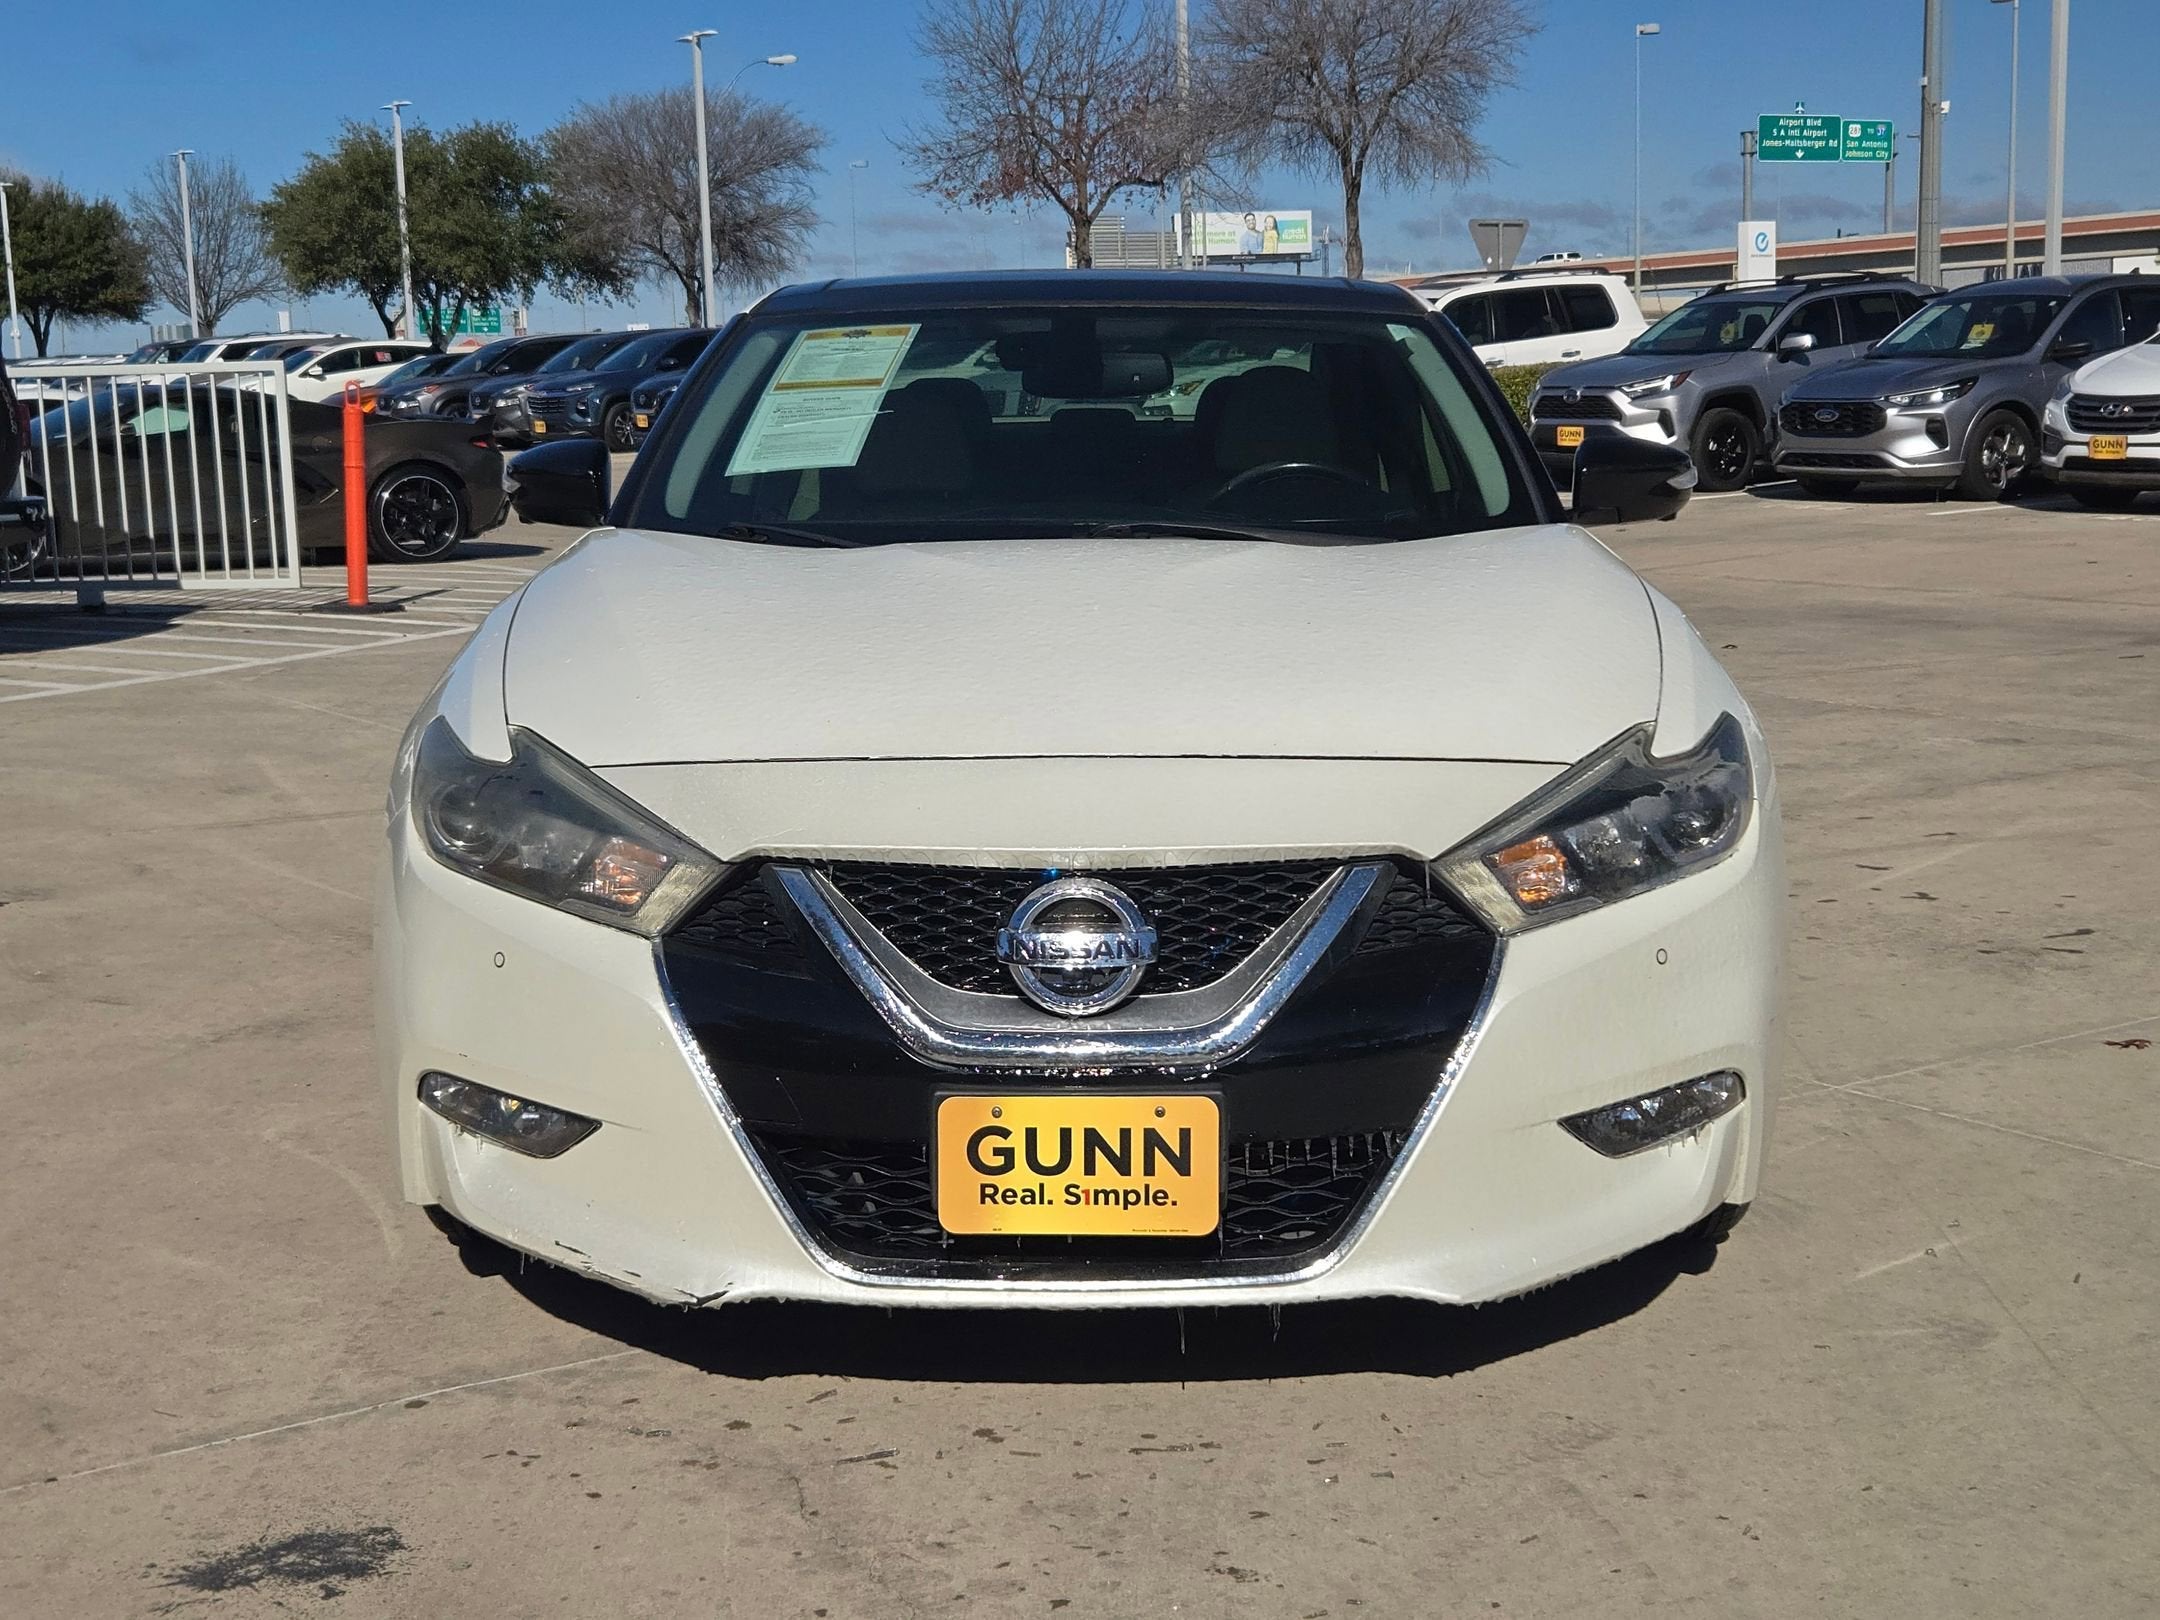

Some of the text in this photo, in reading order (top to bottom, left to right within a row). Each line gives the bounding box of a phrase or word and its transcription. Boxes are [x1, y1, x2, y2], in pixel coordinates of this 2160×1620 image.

[1779, 118, 1822, 127] Airport Blvd
[1803, 129, 1827, 138] Airport
[1829, 139, 1838, 147] Rd
[1862, 140, 1888, 148] Antonio
[1876, 150, 1889, 159] City
[1560, 430, 1581, 438] GUNN
[2093, 439, 2122, 448] GUNN
[1013, 938, 1141, 960] NISSAN
[966, 1125, 1192, 1177] GUNN
[979, 1183, 1053, 1206] Real.
